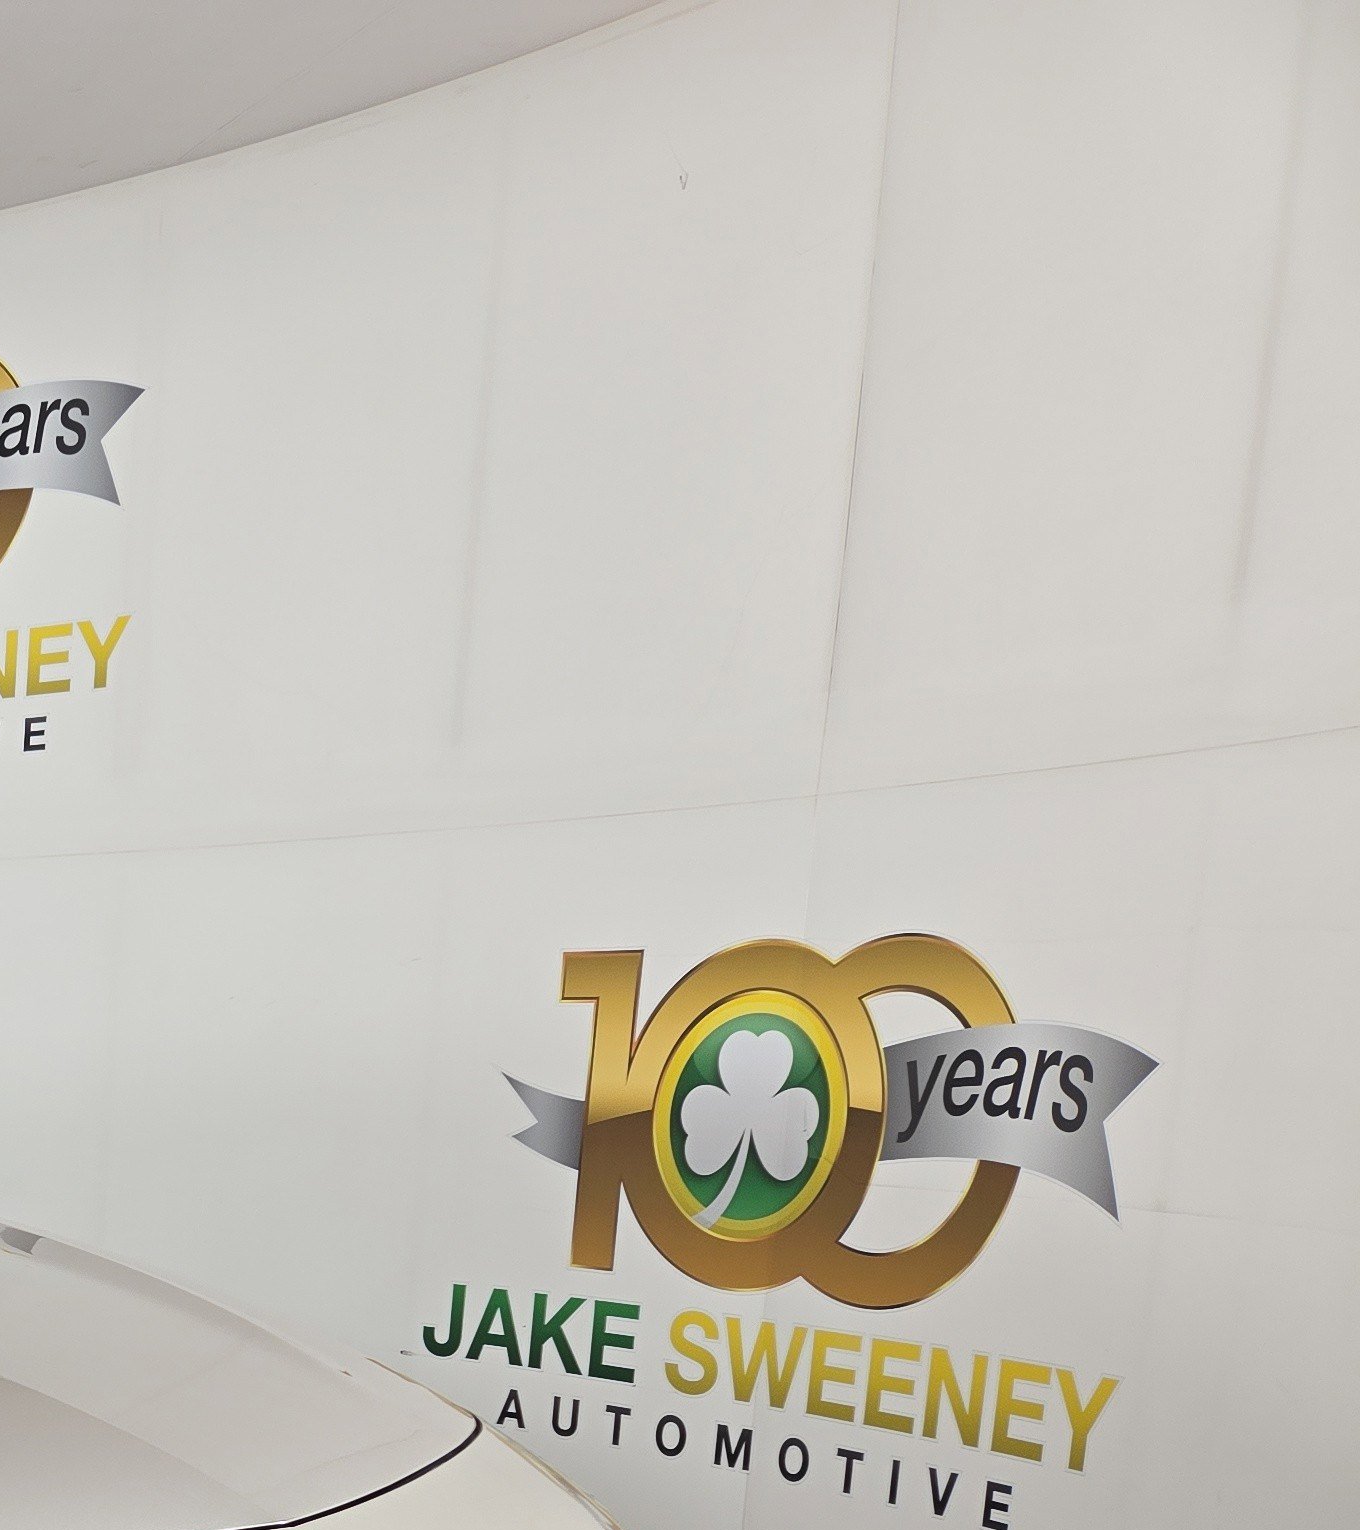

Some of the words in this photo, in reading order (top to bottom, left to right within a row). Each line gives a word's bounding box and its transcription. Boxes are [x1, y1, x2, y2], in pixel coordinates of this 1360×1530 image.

[560, 932, 1021, 1310] 100
[896, 1047, 1094, 1144] years
[422, 1283, 640, 1385] JAKE
[664, 1310, 1119, 1472] SWEENEY
